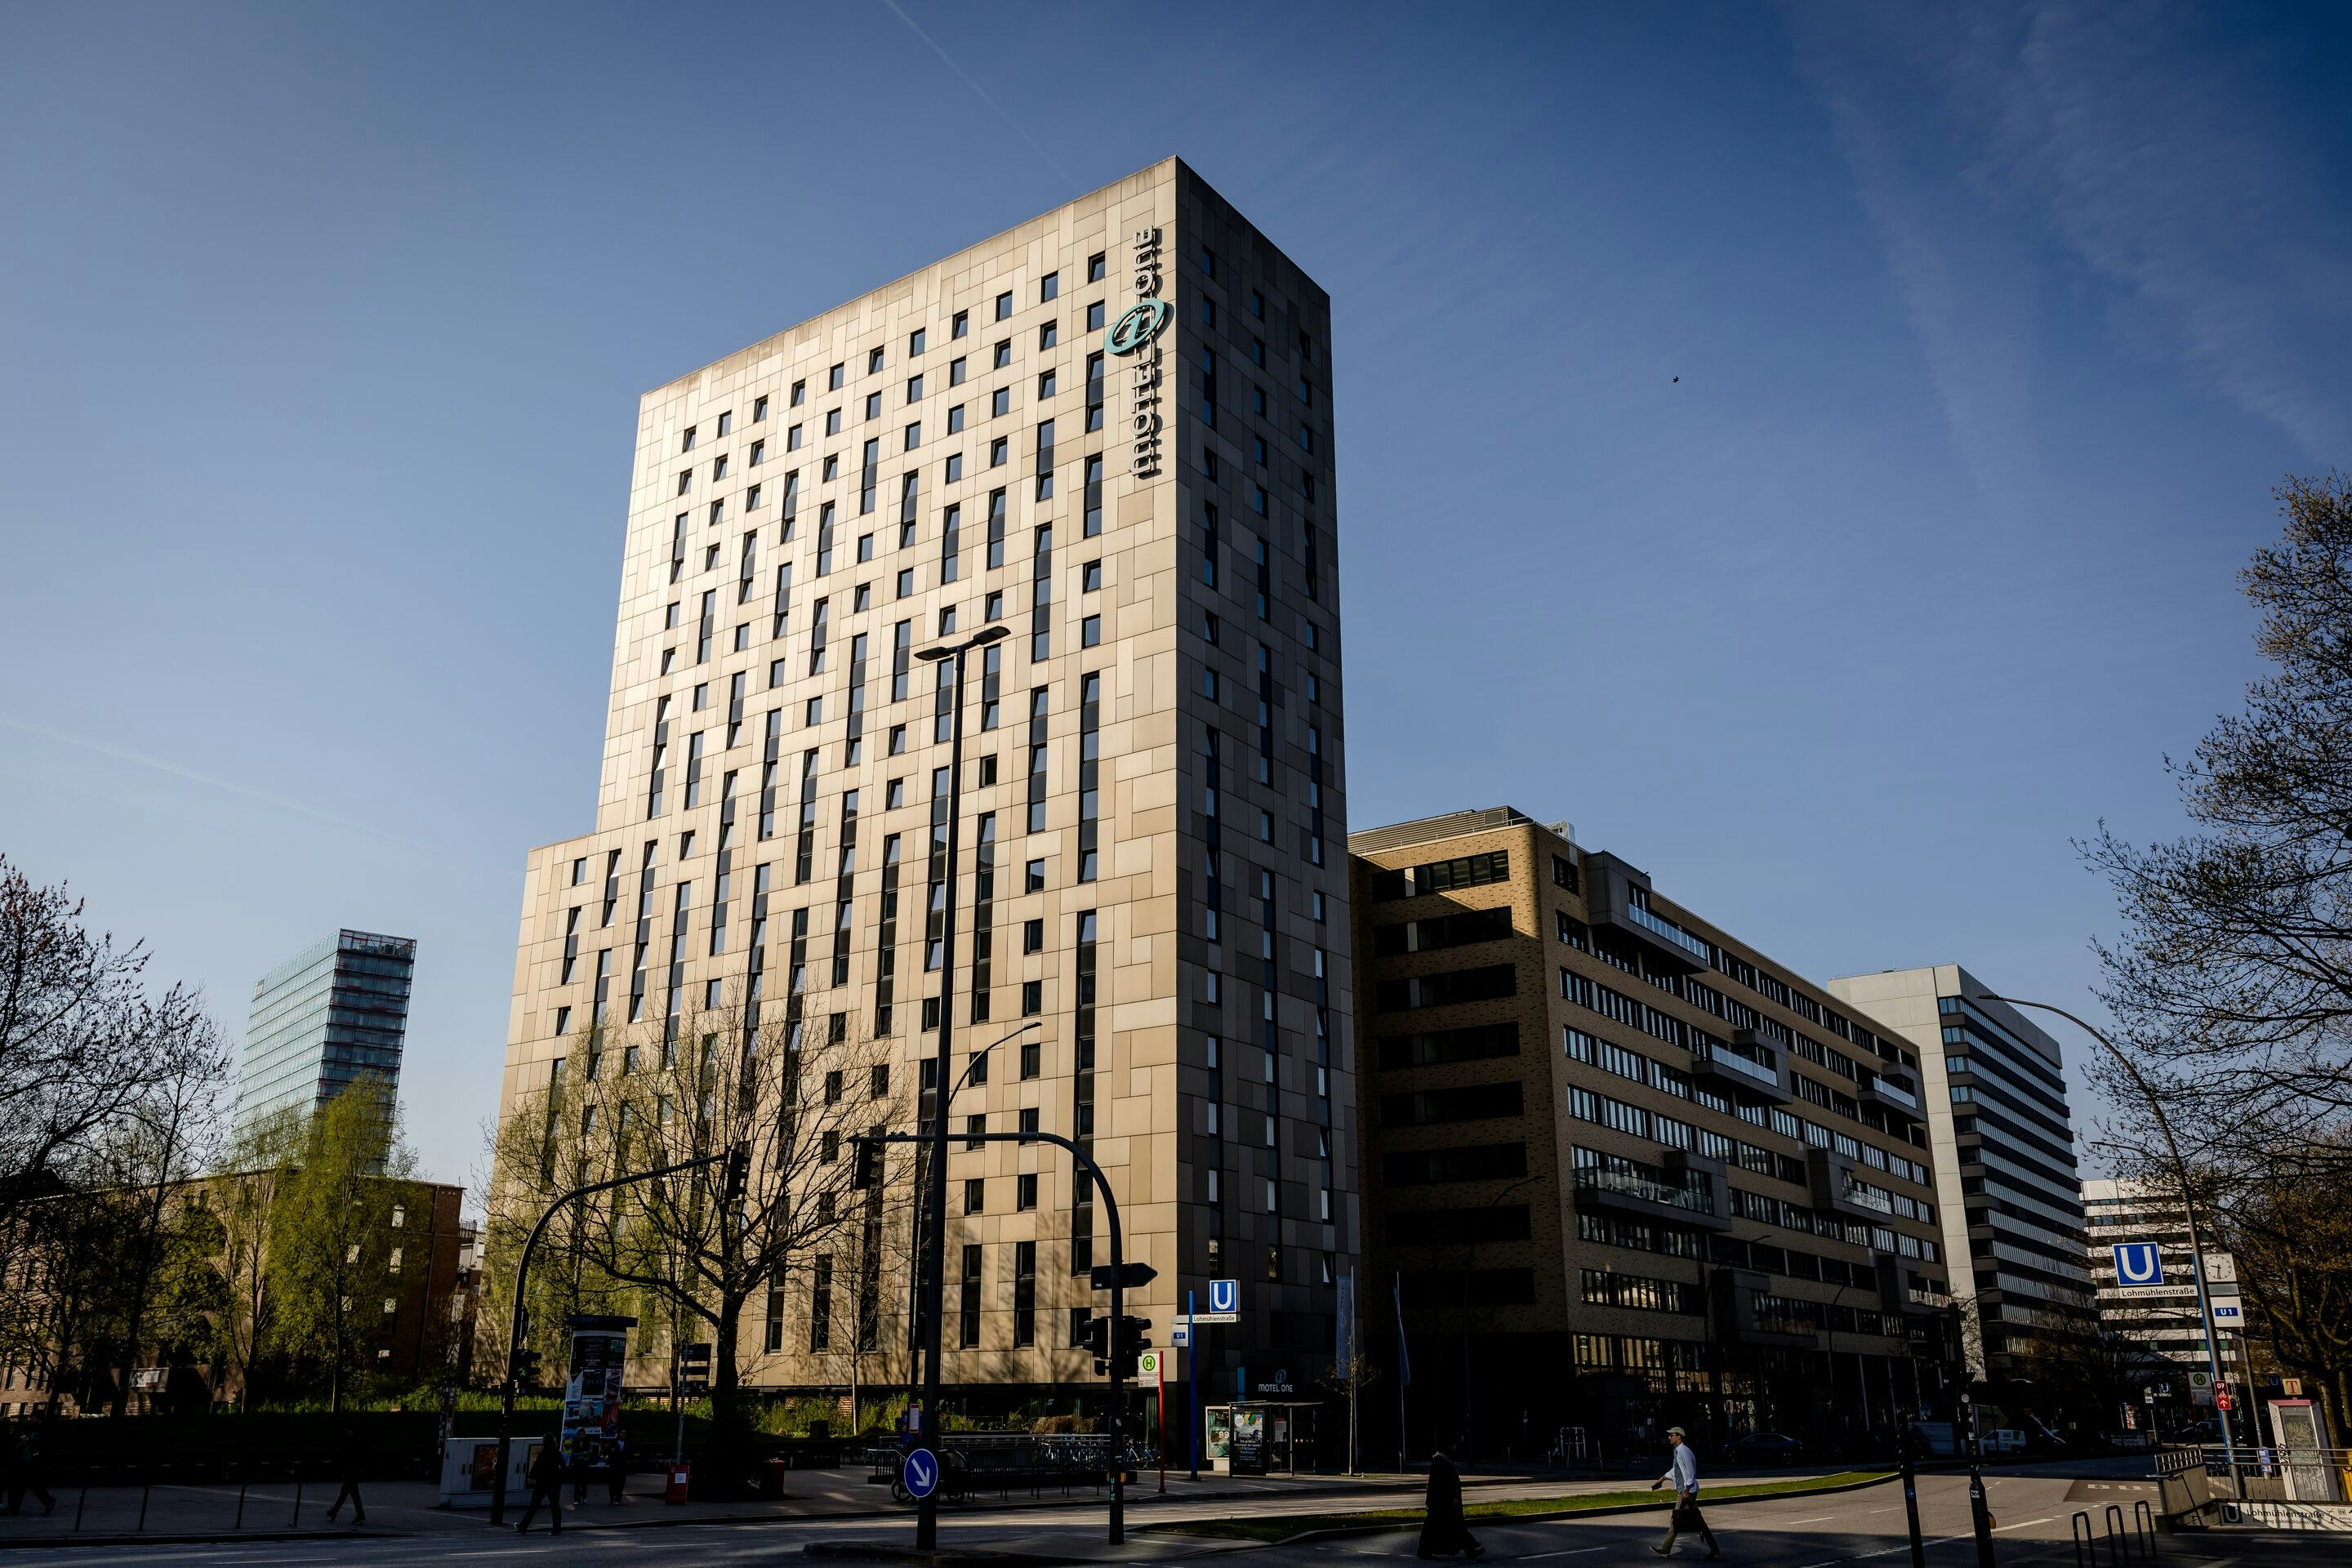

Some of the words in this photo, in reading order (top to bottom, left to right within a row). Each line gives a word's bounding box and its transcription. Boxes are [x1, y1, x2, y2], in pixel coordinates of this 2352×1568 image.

[2119, 1245, 2154, 1281] U
[1214, 1282, 1232, 1310] U
[2122, 1287, 2195, 1297] Lohmühlenstraße
[1258, 1383, 1280, 1392] MOTEL
[1281, 1384, 1294, 1392] ONE
[2287, 1380, 2298, 1394] T
[2224, 1506, 2240, 1523] U
[2247, 1508, 2325, 1519] Lohmühlenstraße
